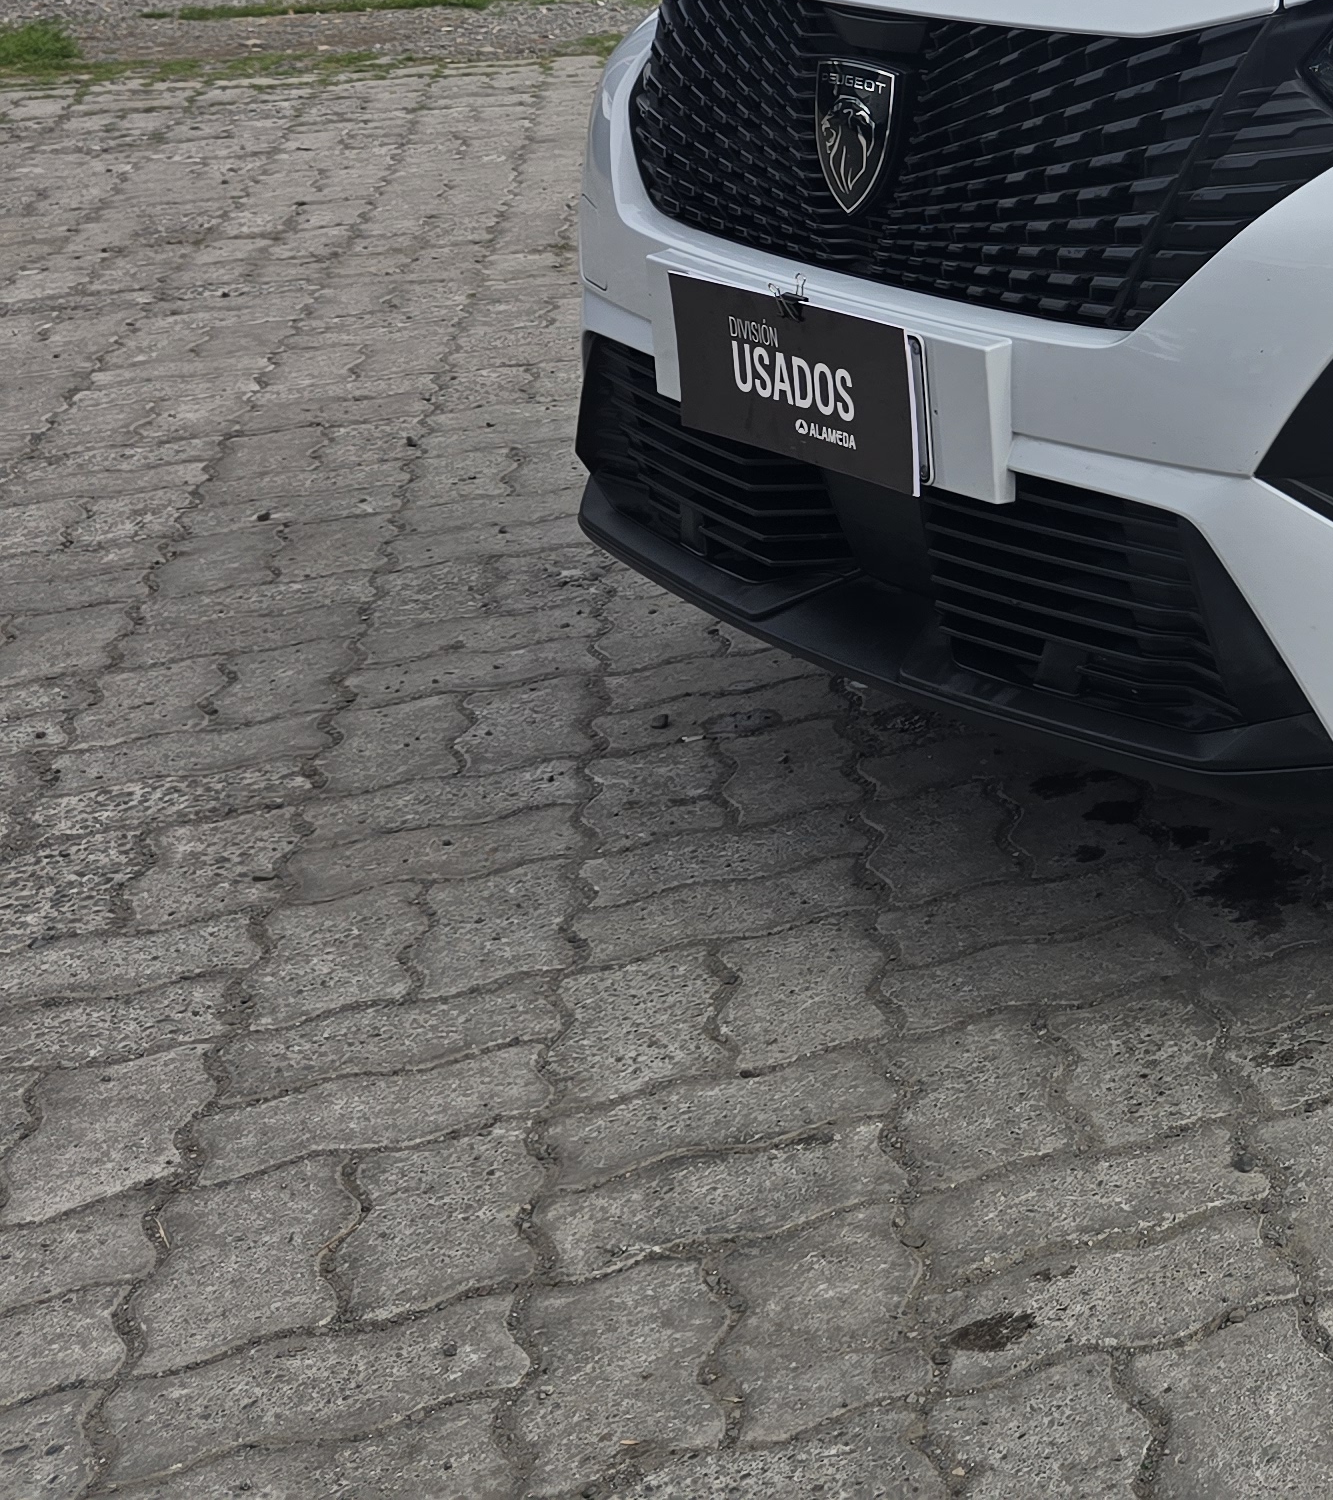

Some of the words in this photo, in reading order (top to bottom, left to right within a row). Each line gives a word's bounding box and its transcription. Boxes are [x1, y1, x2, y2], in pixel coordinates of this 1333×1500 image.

[821, 72, 887, 95] PEUGEOT
[728, 315, 779, 348] DIVISIÓN
[731, 340, 855, 422] USADOS
[809, 422, 857, 450] ALAMEDA
